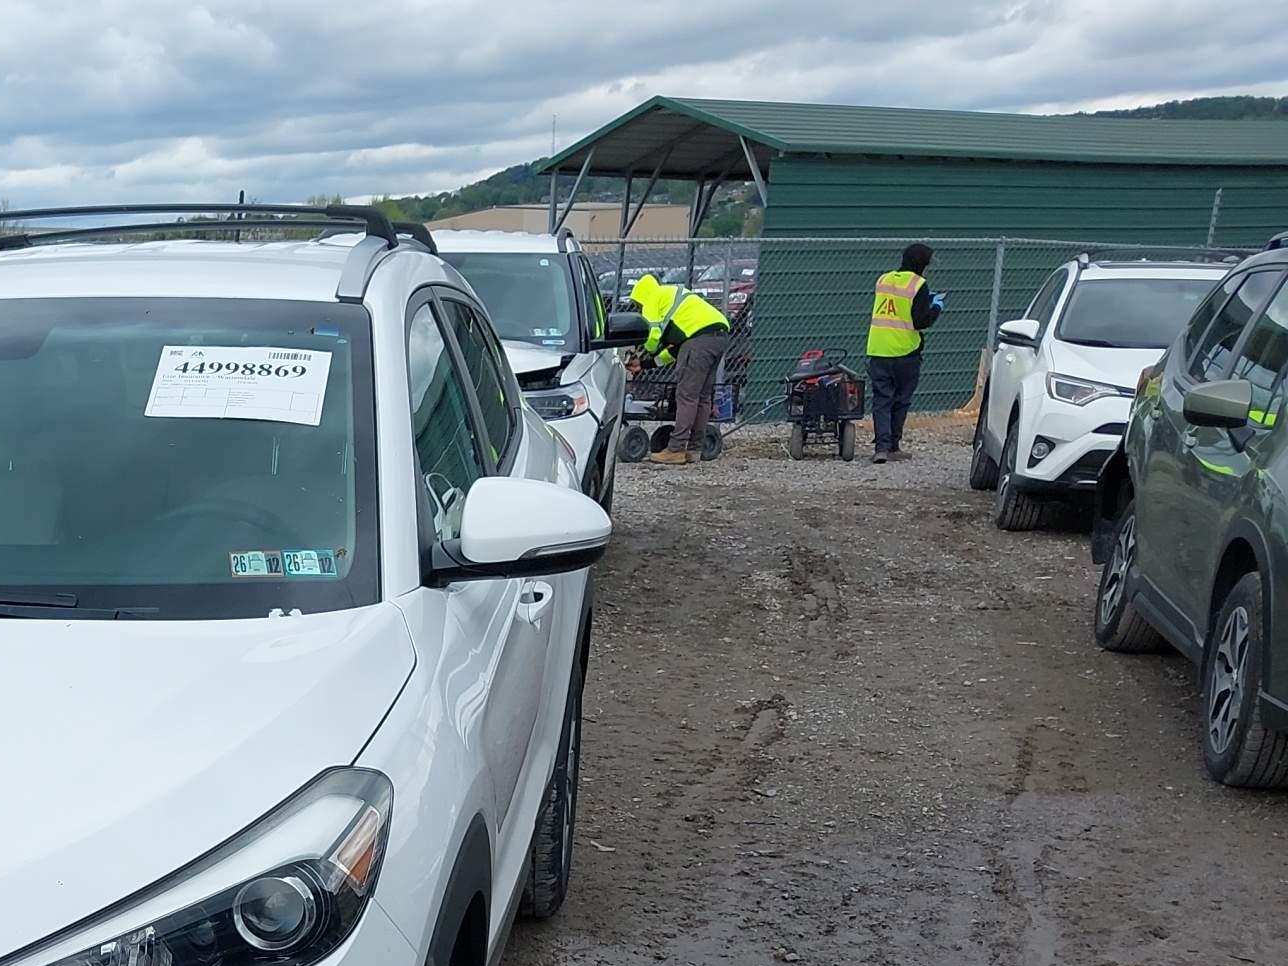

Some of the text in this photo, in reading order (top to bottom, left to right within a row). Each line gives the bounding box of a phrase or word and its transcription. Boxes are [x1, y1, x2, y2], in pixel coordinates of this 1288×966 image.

[174, 361, 307, 379] 44998869
[232, 555, 282, 574] 26 12
[287, 554, 333, 573] 26 12
